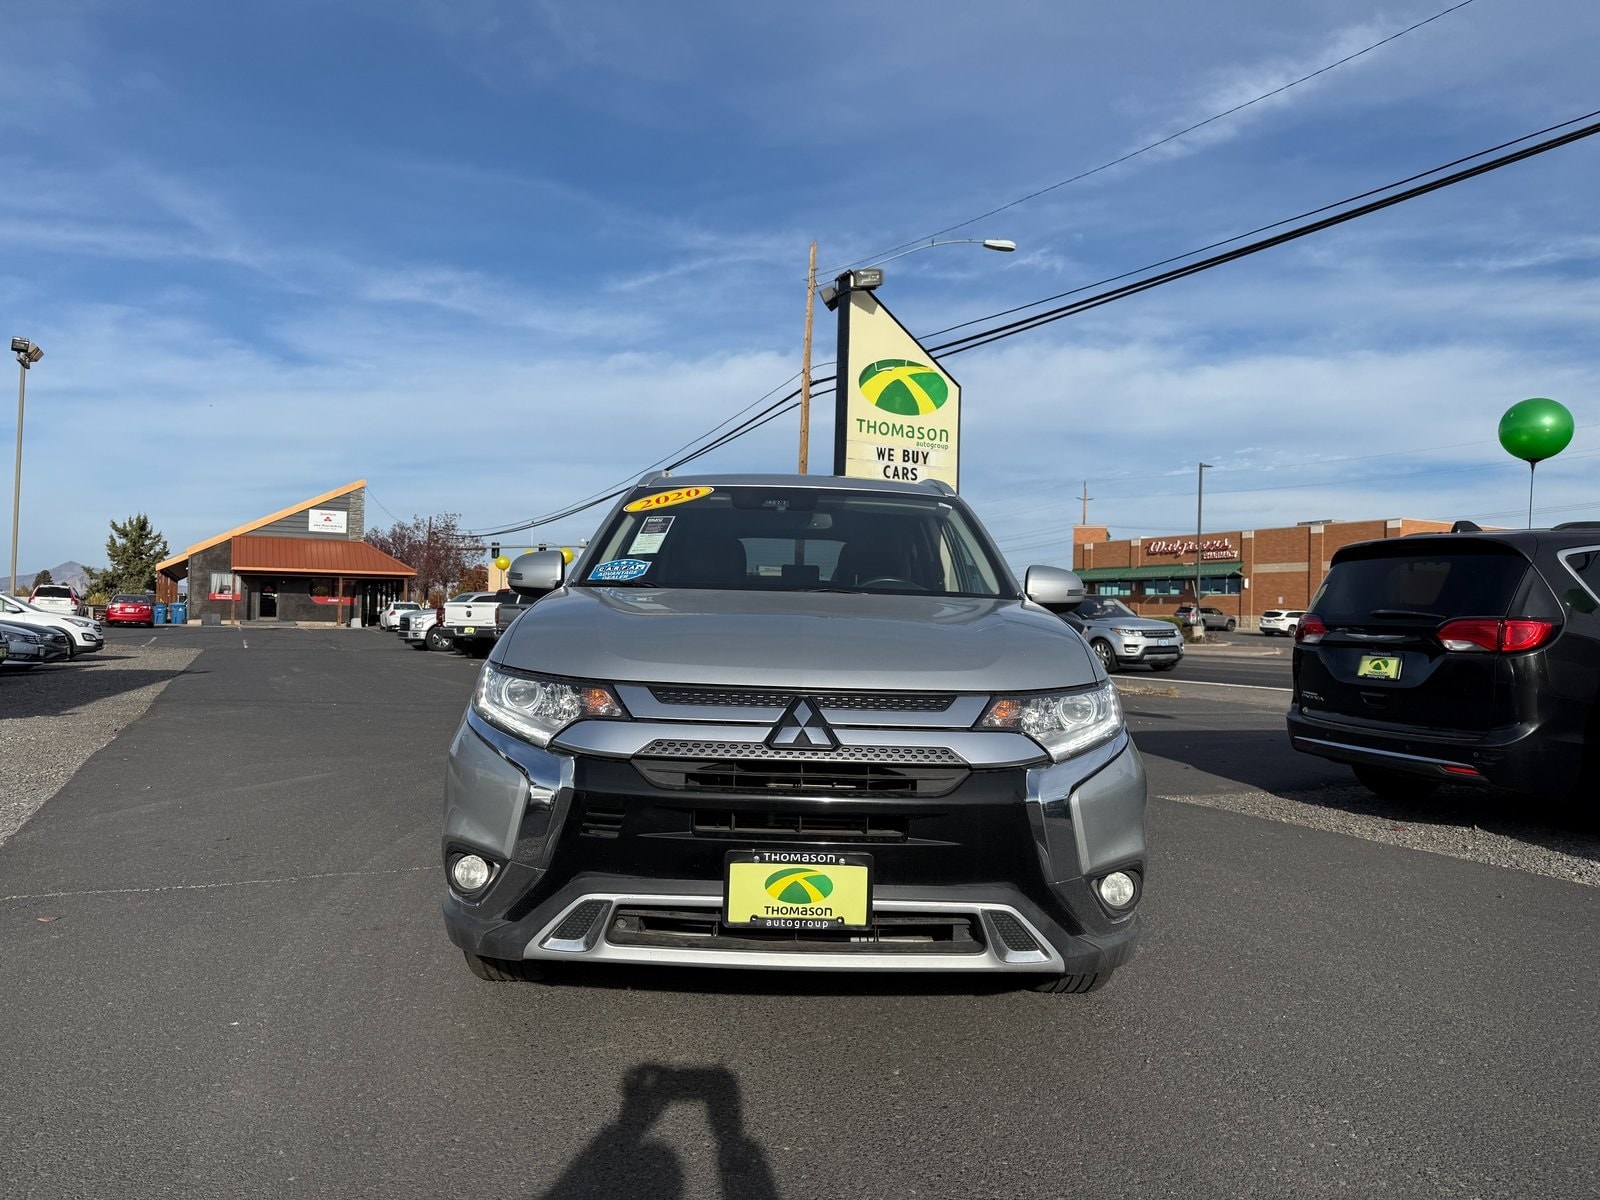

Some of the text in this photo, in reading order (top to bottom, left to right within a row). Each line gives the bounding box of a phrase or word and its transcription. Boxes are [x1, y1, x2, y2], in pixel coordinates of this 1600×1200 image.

[856, 418, 949, 442] THOMason
[915, 441, 949, 450] autogroup
[876, 446, 930, 465] WE BUY
[883, 465, 917, 481] CARS
[640, 488, 700, 510] 2020
[764, 852, 836, 864] THOMason
[764, 905, 833, 917] THOMason
[766, 918, 829, 929] autogroup
